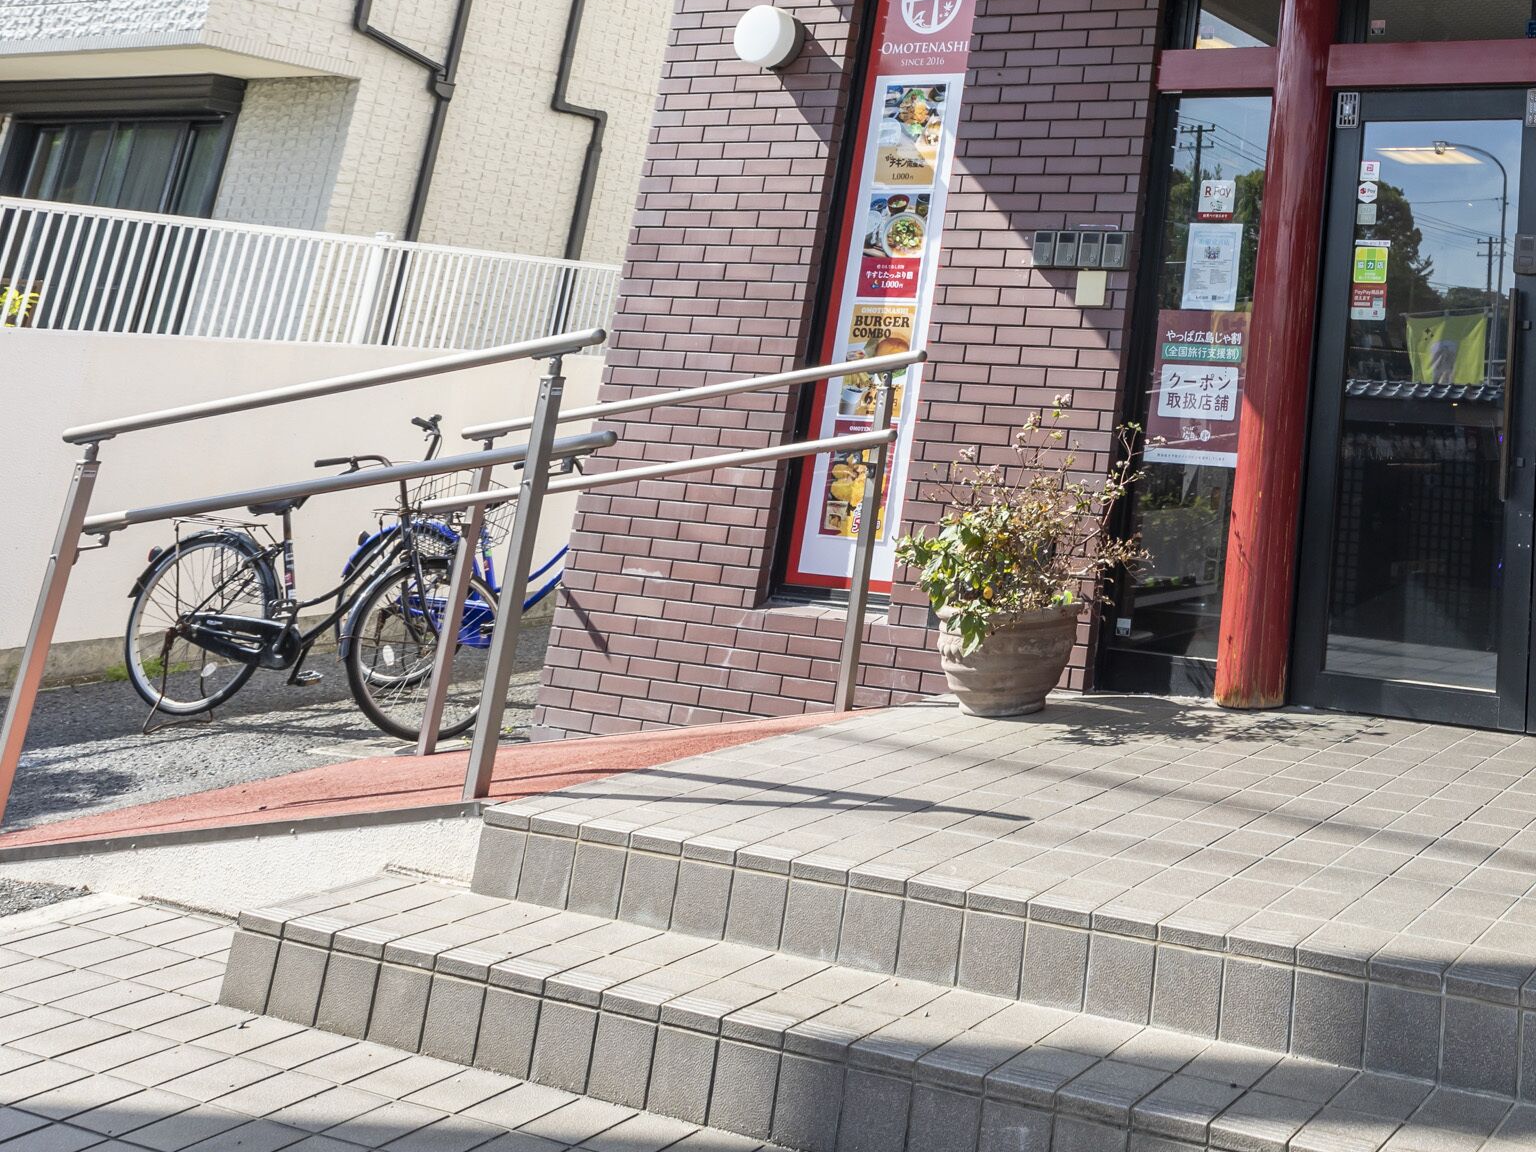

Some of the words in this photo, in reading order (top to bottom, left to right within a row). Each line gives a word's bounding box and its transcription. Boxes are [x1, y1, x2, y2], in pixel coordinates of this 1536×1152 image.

[881, 40, 970, 55] OMOTENASHI
[900, 58, 926, 67] SINCE
[926, 56, 945, 66] 2016
[853, 315, 910, 328] BURGER
[852, 327, 892, 339] COMBO
[1169, 372, 1231, 391] クーポン
[1166, 392, 1230, 412] 取扱店舗
